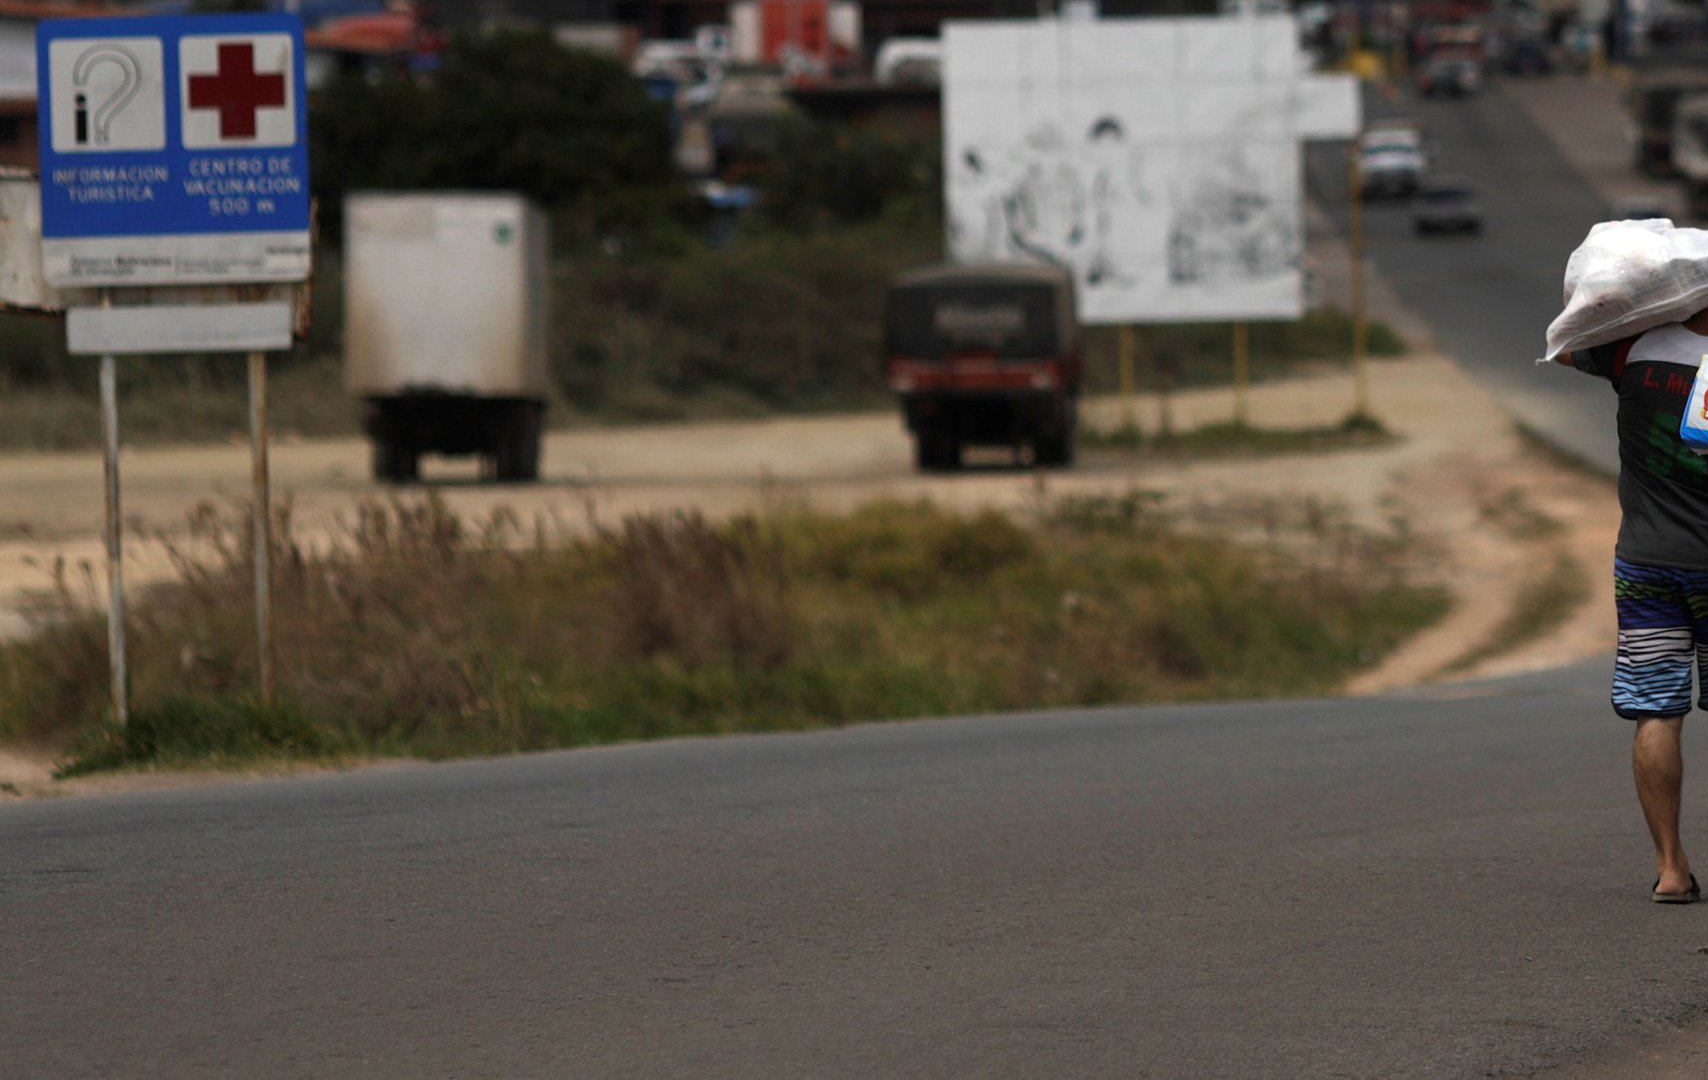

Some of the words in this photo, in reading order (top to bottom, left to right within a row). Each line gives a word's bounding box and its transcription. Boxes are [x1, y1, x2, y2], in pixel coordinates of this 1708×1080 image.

[52, 165, 170, 184] INFORMACION
[189, 156, 264, 177] CENTRO
[268, 155, 292, 175] DE
[68, 184, 155, 204] TURISTICA
[183, 176, 301, 196] VACUNACION
[208, 197, 250, 217] 500
